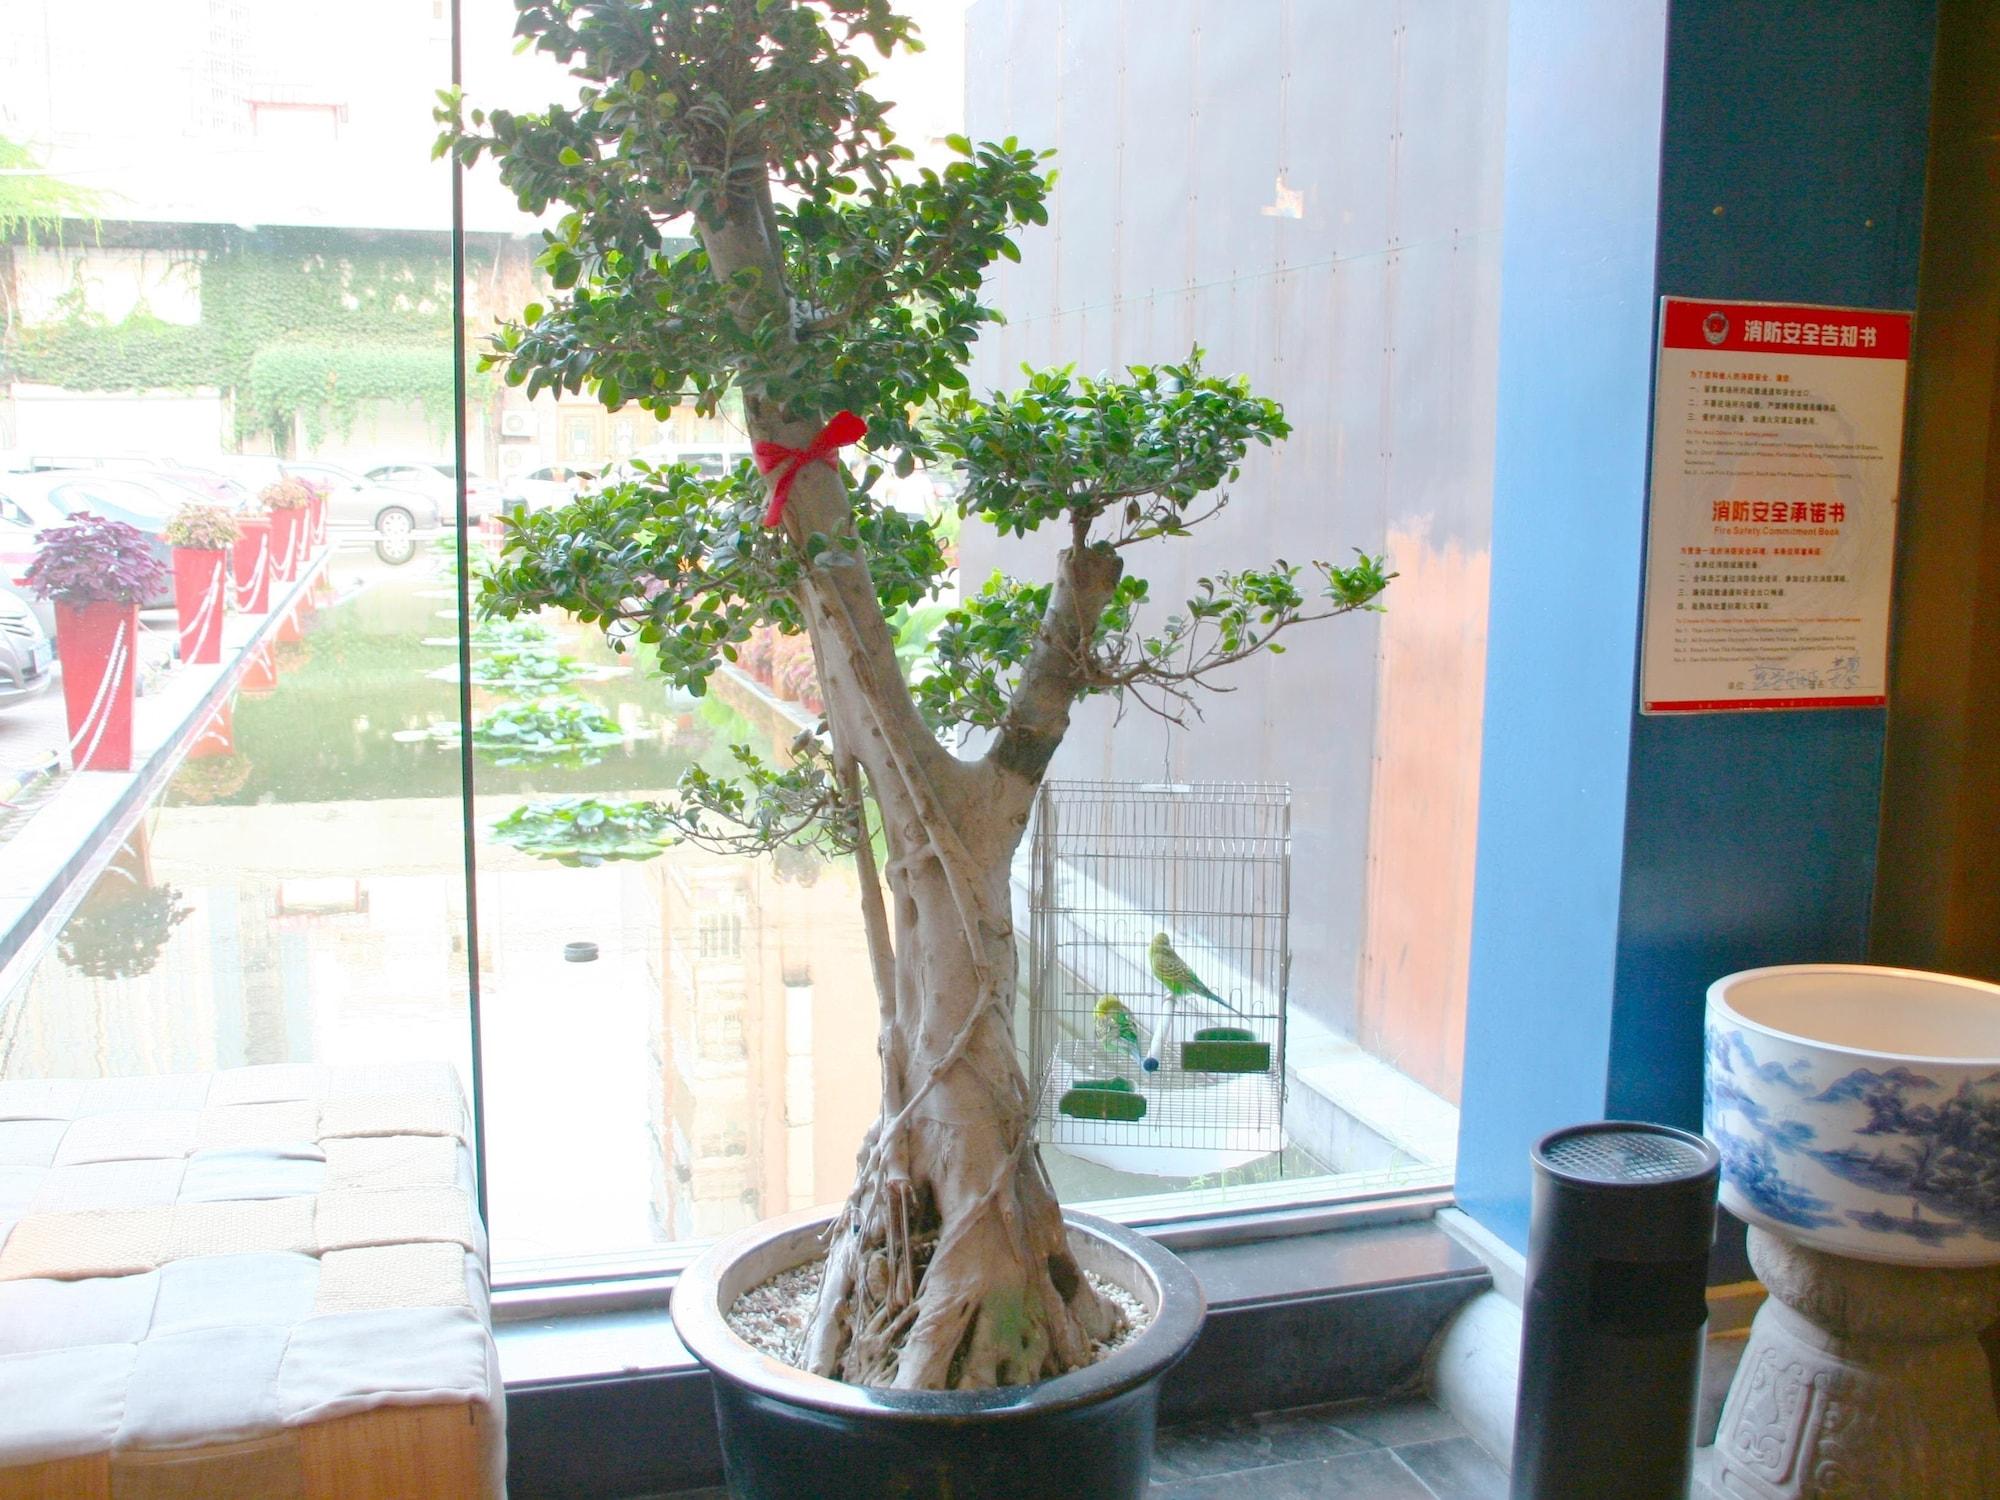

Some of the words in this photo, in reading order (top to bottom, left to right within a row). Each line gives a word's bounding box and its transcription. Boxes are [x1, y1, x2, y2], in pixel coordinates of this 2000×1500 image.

[1743, 319, 1878, 349] 消防安全告知书
[1712, 501, 1846, 524] 消防安全承诺书
[1714, 526, 1733, 536] Fire
[1735, 526, 1760, 538] Safety
